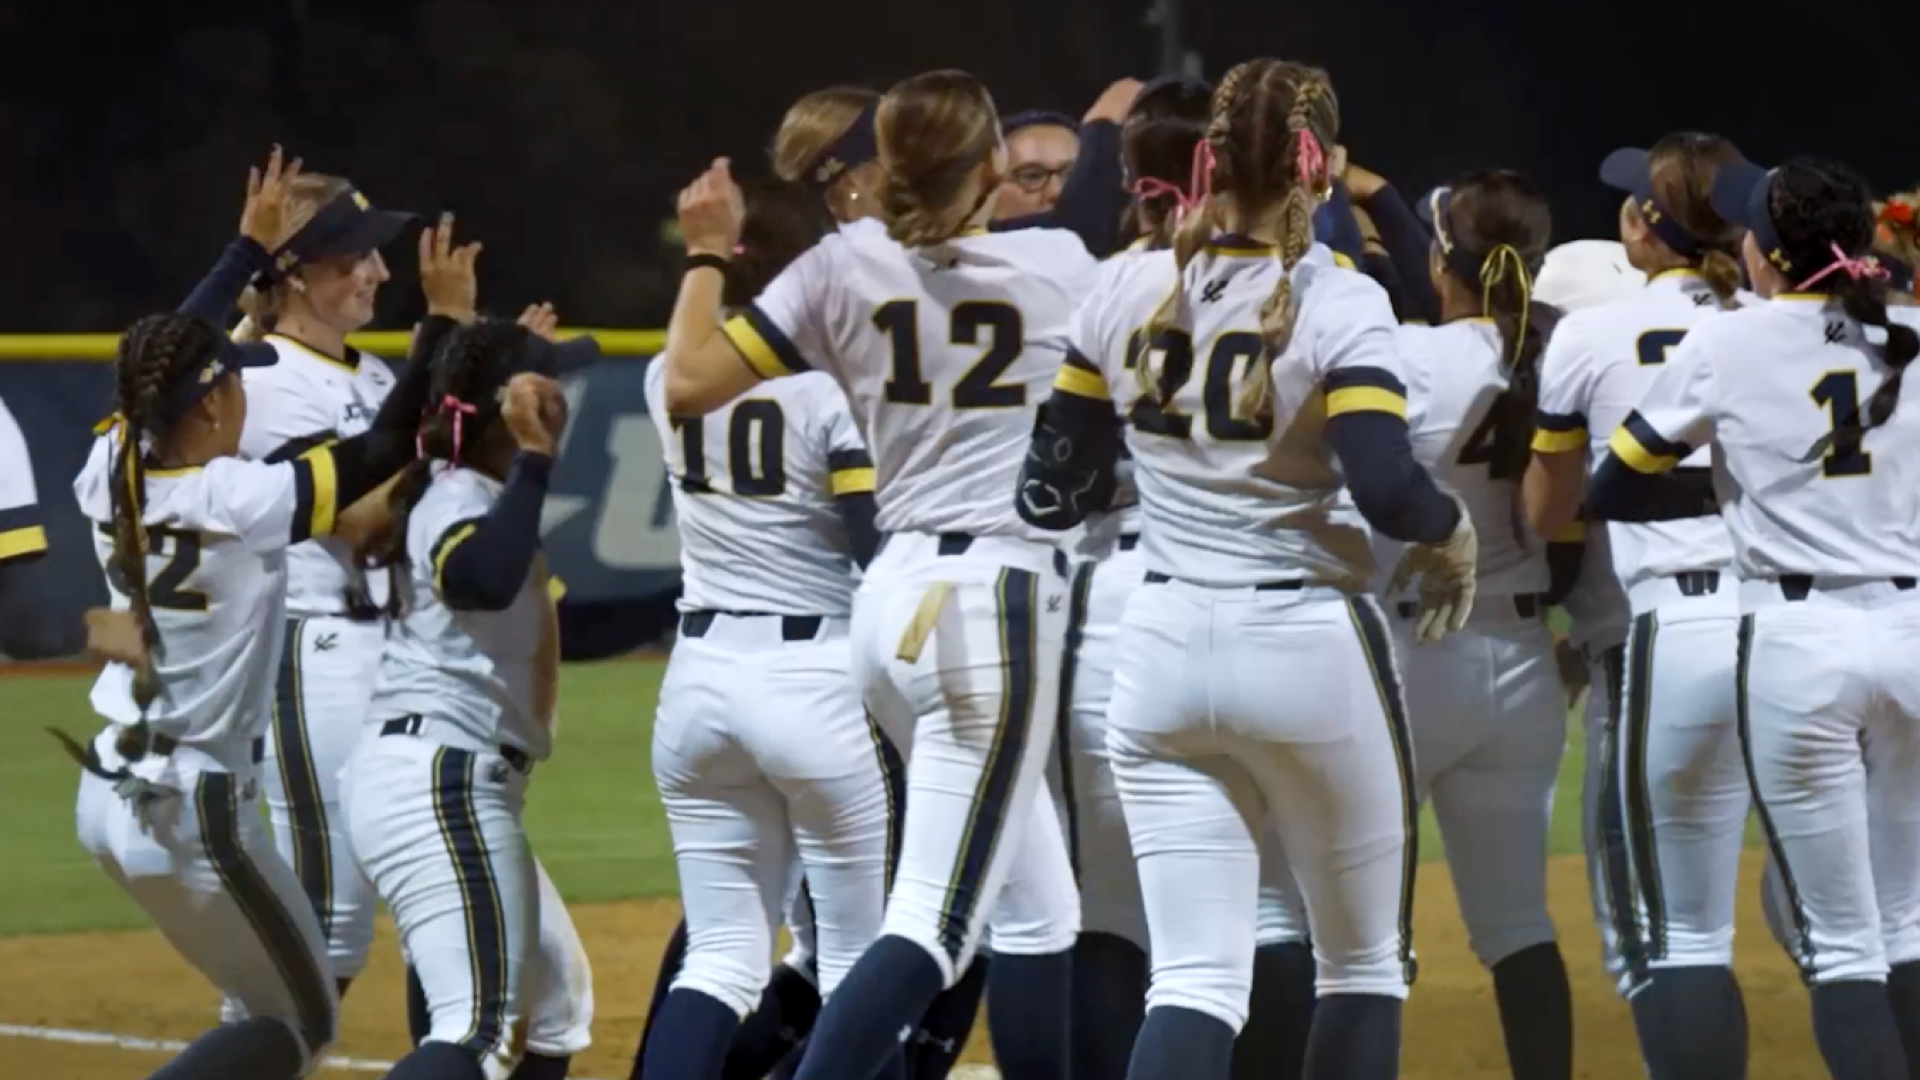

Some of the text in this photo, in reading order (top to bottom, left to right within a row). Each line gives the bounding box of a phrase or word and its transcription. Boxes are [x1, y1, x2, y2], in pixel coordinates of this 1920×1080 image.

[871, 297, 1027, 409] 12
[1124, 326, 1275, 441] 20
[670, 397, 786, 497] 10
[1810, 369, 1872, 478] 1
